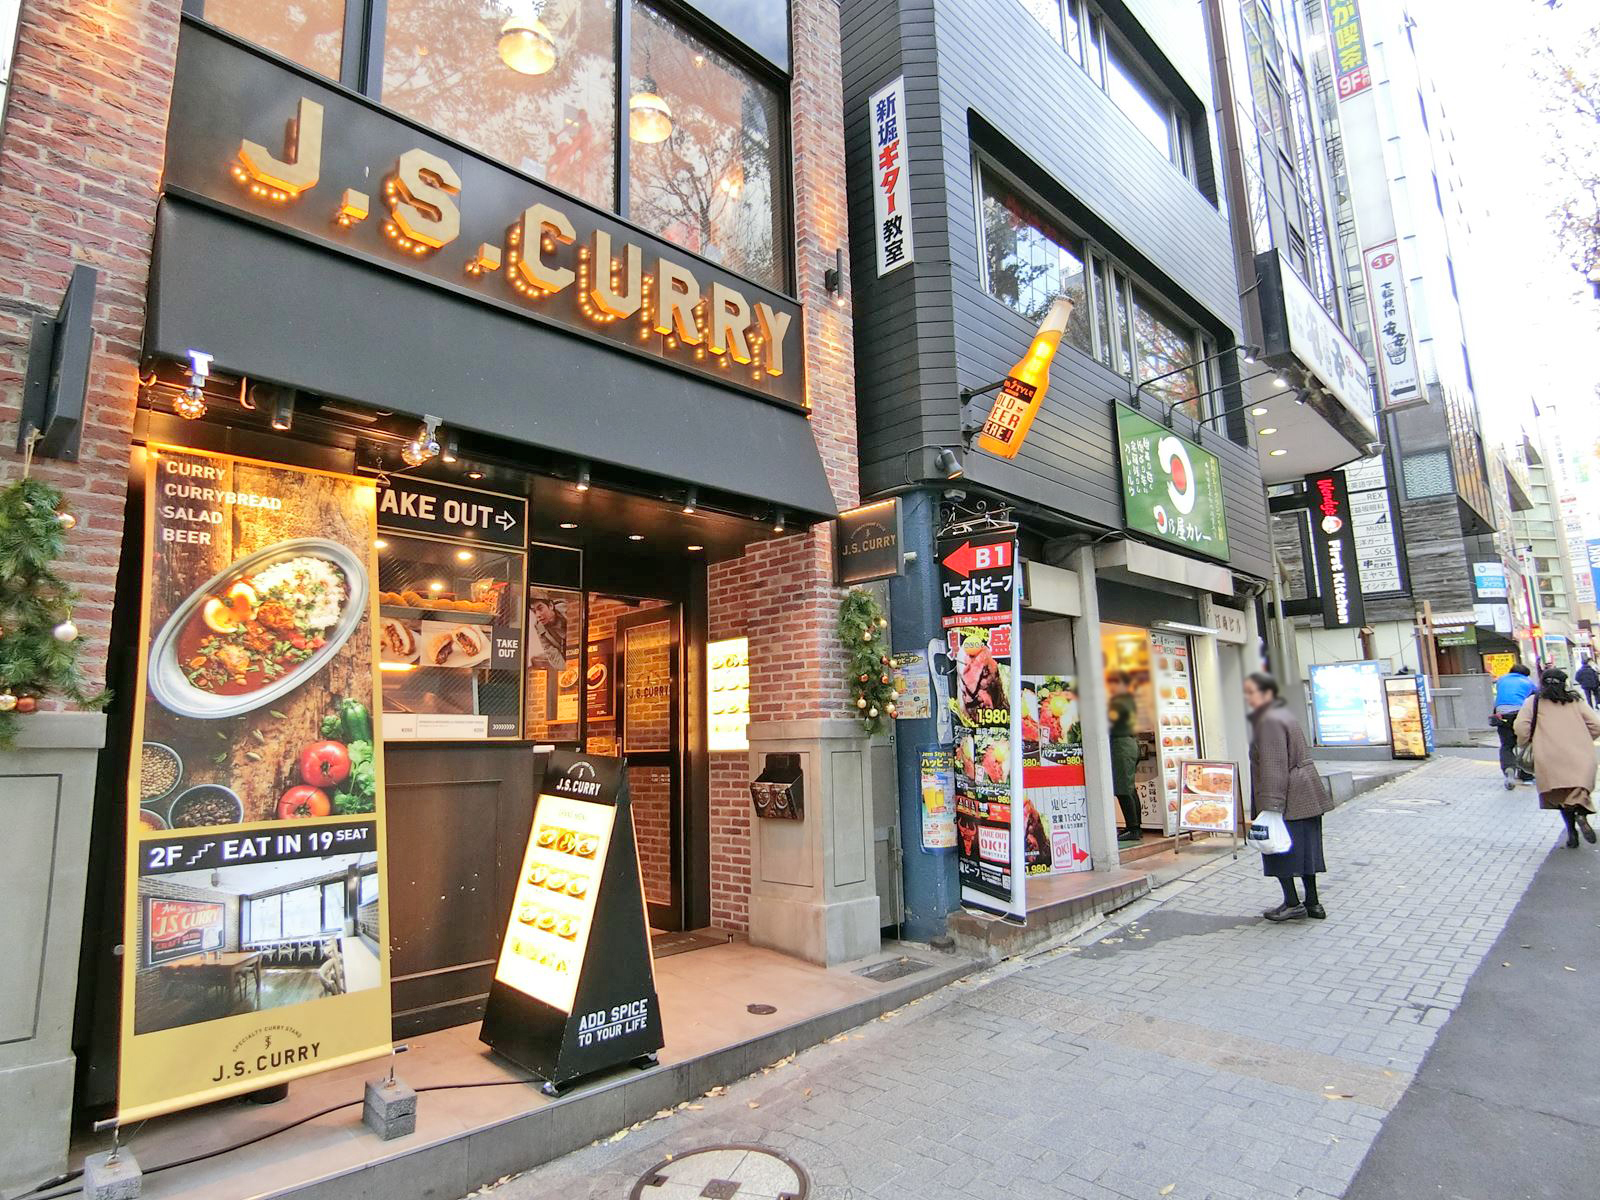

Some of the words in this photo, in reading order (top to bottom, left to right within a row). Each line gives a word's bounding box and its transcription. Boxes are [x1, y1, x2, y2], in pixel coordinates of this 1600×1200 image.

[1330, 0, 1363, 72] が喫茶
[1340, 76, 1362, 96] 9F
[877, 91, 904, 268] 新堀ギター教室
[238, 97, 792, 377] J.S.CURRY
[1373, 255, 1394, 268] 3F
[996, 394, 1016, 410] OLD
[991, 406, 1020, 429] EER
[983, 421, 1012, 441] ERE!
[166, 461, 226, 481] CURRY
[164, 483, 282, 510] CURRYBREAD
[1366, 492, 1384, 501] REX
[163, 505, 223, 524] SALAD
[443, 499, 493, 529] OUT
[162, 527, 211, 545] BEER
[976, 545, 1004, 568] B1
[1374, 547, 1392, 556] SGS
[944, 575, 1013, 599] ローストビーフ
[951, 594, 999, 614] 専門店
[1332, 572, 1349, 624] Kitchen
[496, 638, 519, 649] TAKE
[498, 648, 516, 659] OUT
[977, 708, 1008, 726] 1,980
[556, 778, 601, 796] J.S.CURRY
[149, 845, 184, 868] 2F
[223, 837, 271, 861] EAT
[277, 834, 302, 854] IN
[309, 831, 334, 852] 19
[335, 827, 369, 842] SEAT
[579, 1008, 606, 1032] ADD
[611, 999, 648, 1022] SPICE
[578, 1029, 594, 1047] TO
[596, 1022, 622, 1042] YOUR
[625, 1015, 648, 1034] LIFE
[212, 1041, 320, 1082] J.S.CURRY
